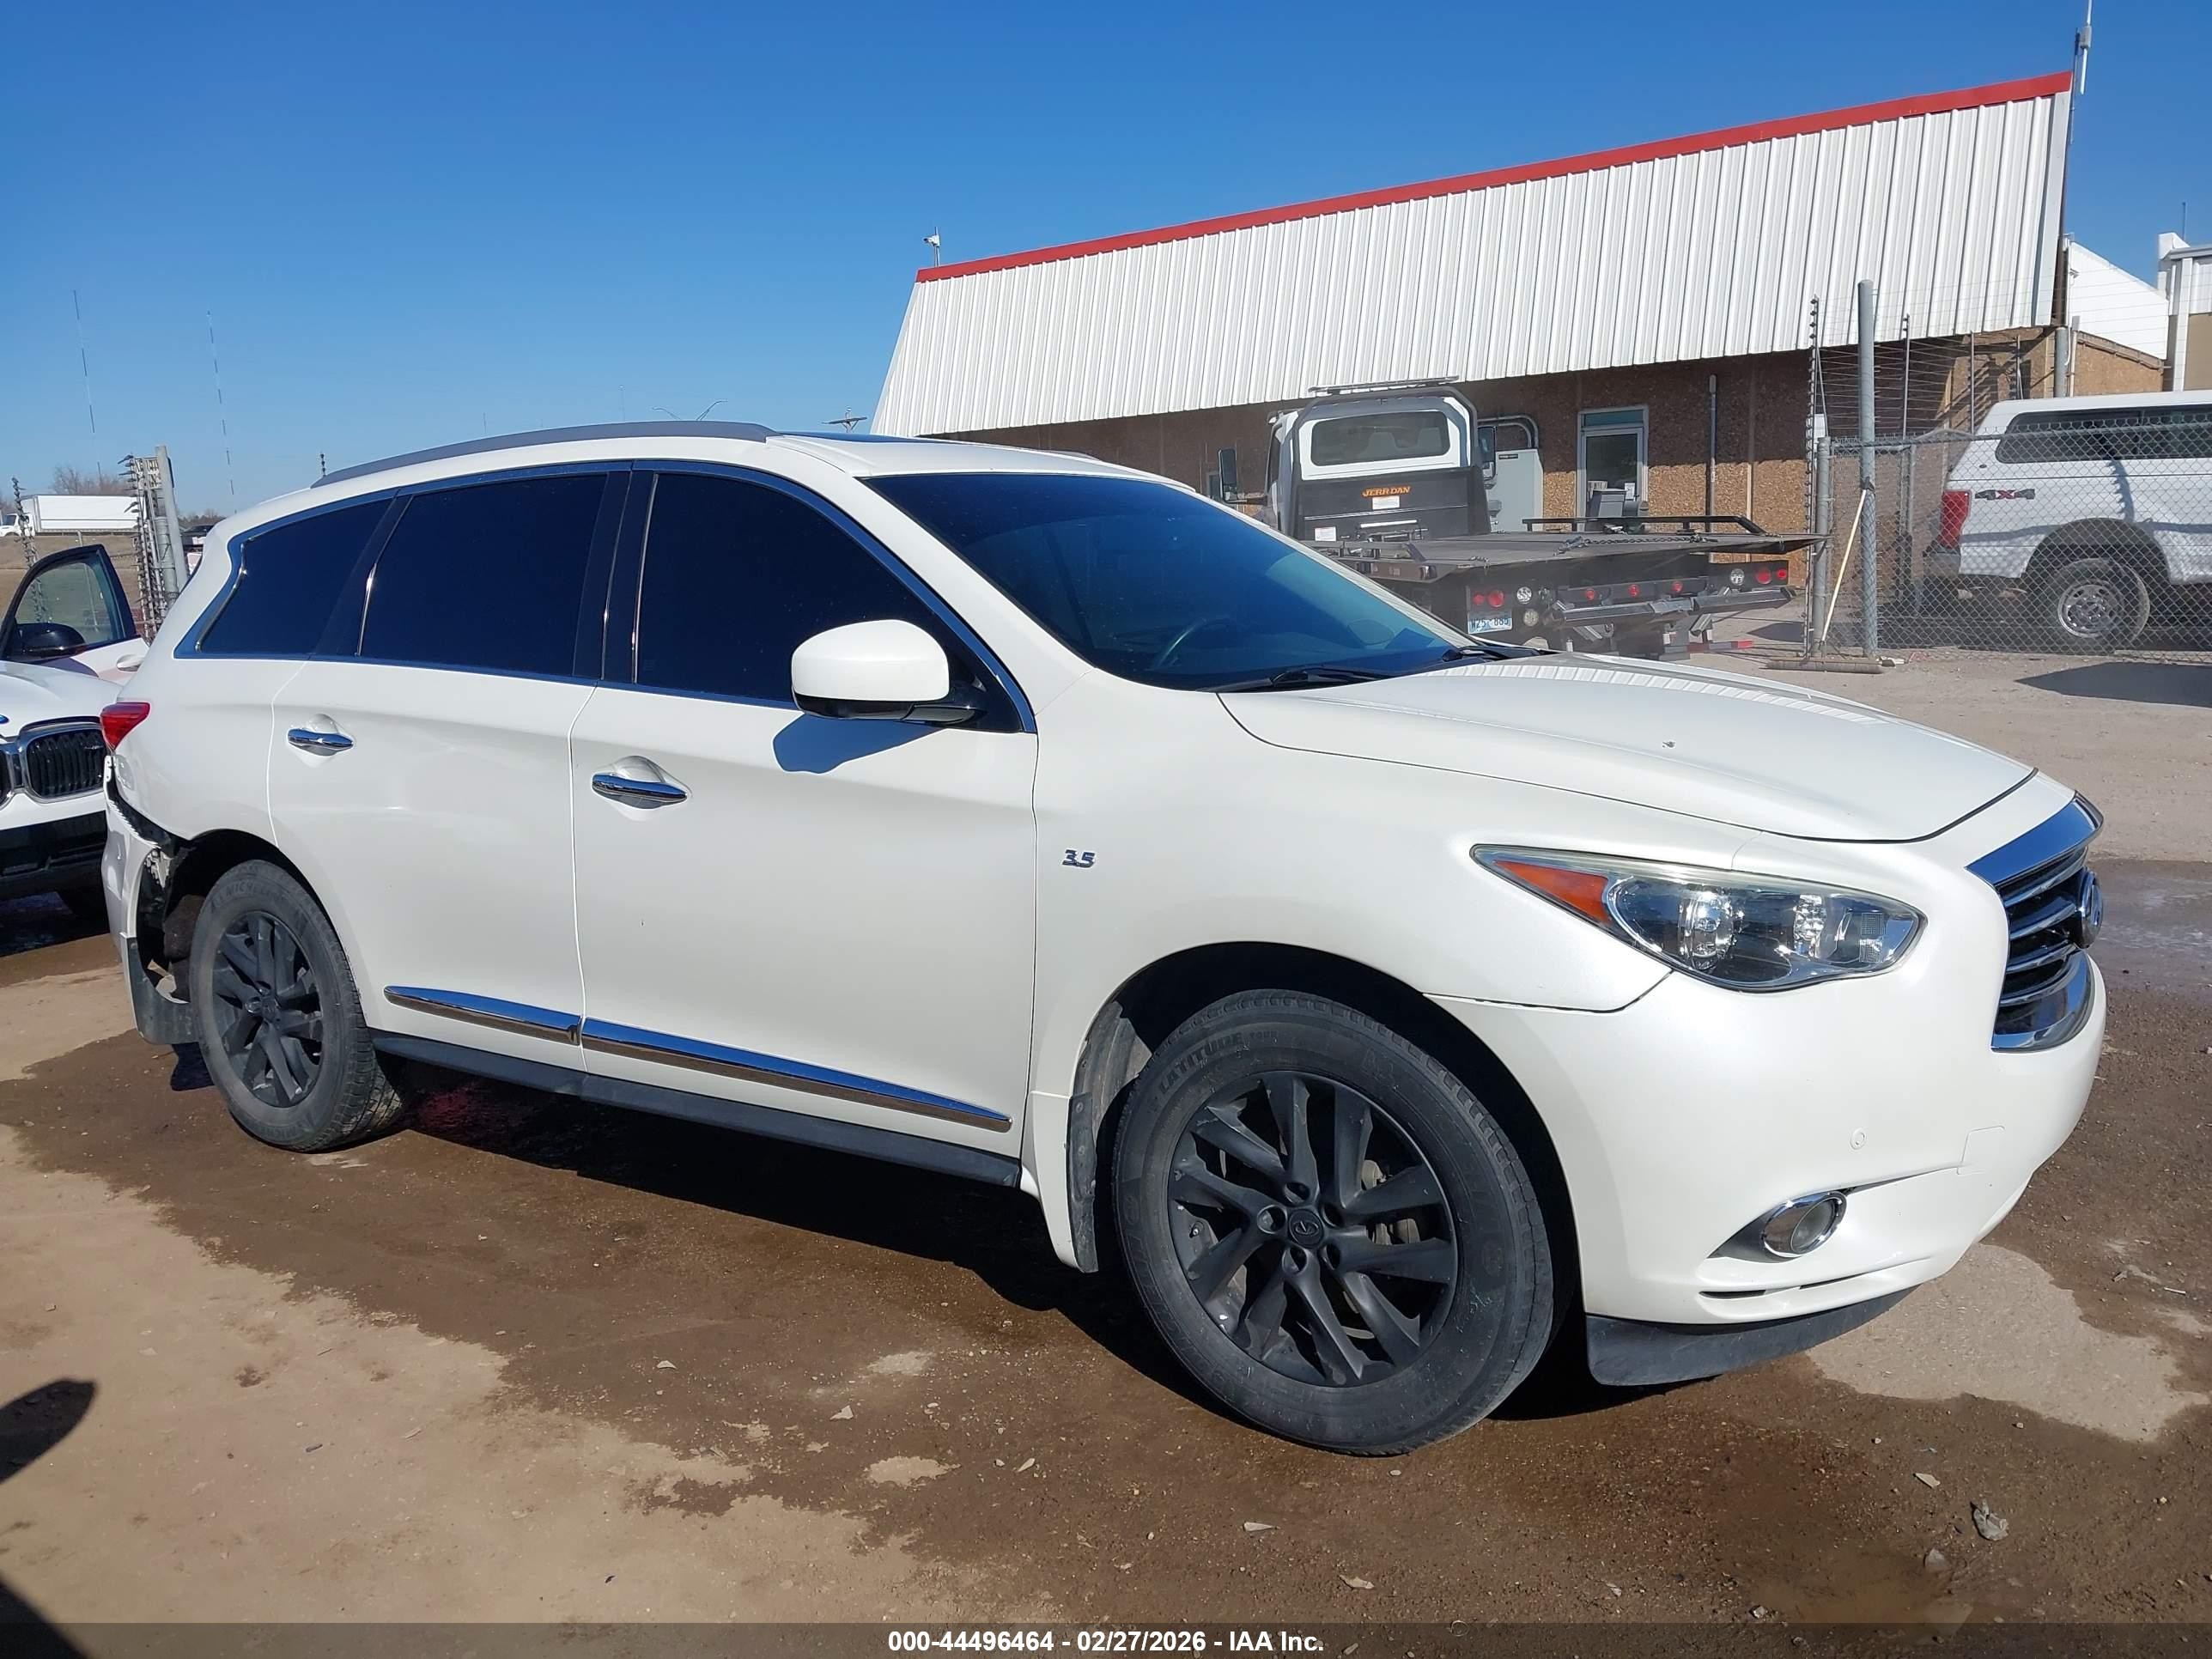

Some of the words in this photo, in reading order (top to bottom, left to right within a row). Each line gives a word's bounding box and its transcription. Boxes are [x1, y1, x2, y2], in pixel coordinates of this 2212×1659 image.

[1362, 487, 1389, 497] JERR
[1389, 485, 1411, 495] DAN
[1061, 848, 1096, 868] 3.5
[1158, 1030, 1243, 1094] LATITUDE
